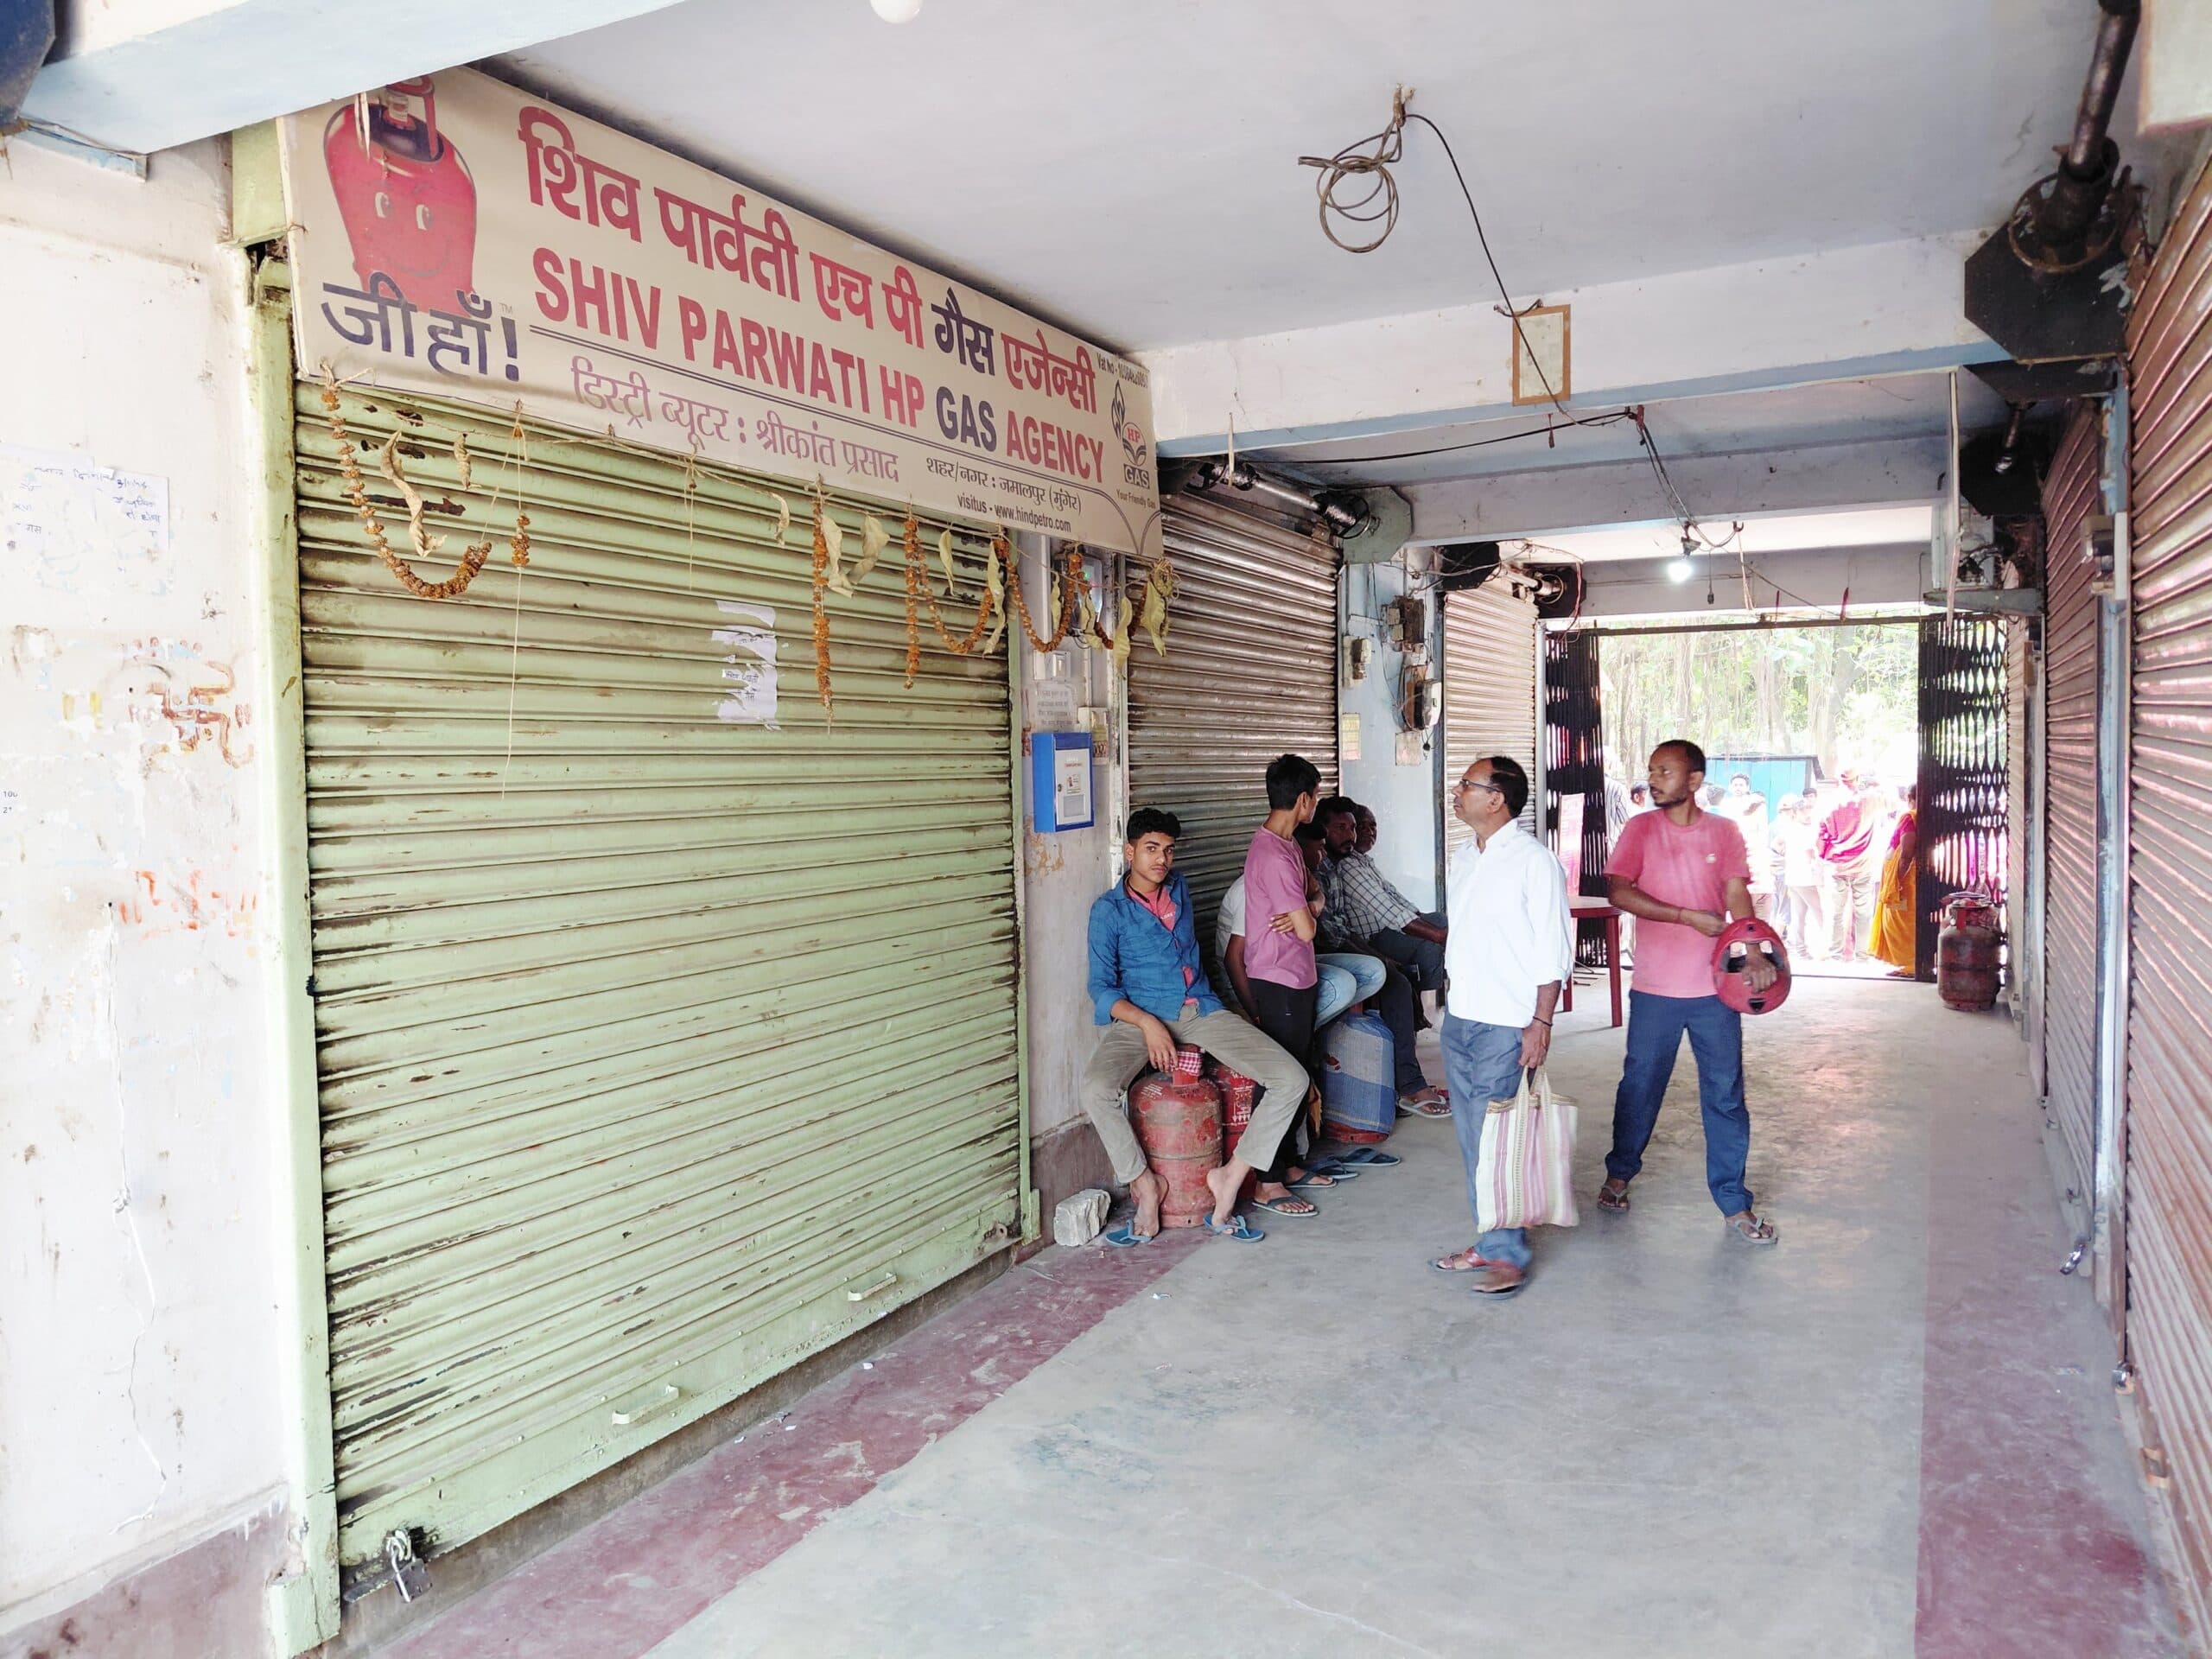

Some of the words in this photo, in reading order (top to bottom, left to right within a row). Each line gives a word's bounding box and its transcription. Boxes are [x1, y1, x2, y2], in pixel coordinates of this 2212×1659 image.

[518, 105, 642, 243] शिव
[653, 193, 800, 302] पार्वती
[809, 251, 874, 330] एच
[881, 264, 925, 350] पी
[931, 286, 995, 376] गैस
[1001, 327, 1098, 414] एजेन्सी
[321, 271, 417, 358] जी
[533, 247, 661, 350] SHIV
[678, 295, 871, 415] PARWATI
[880, 365, 925, 429] HP
[936, 386, 997, 453] GAS
[1007, 410, 1104, 484] AGENCY
[756, 410, 836, 467] श्रीकांत
[841, 441, 900, 483] प्रसाद
[1126, 427, 1141, 444] HP
[999, 476, 1046, 506] जमालपुर
[1125, 466, 1149, 488] GAS
[994, 504, 1072, 533] www.hindpetro.com
